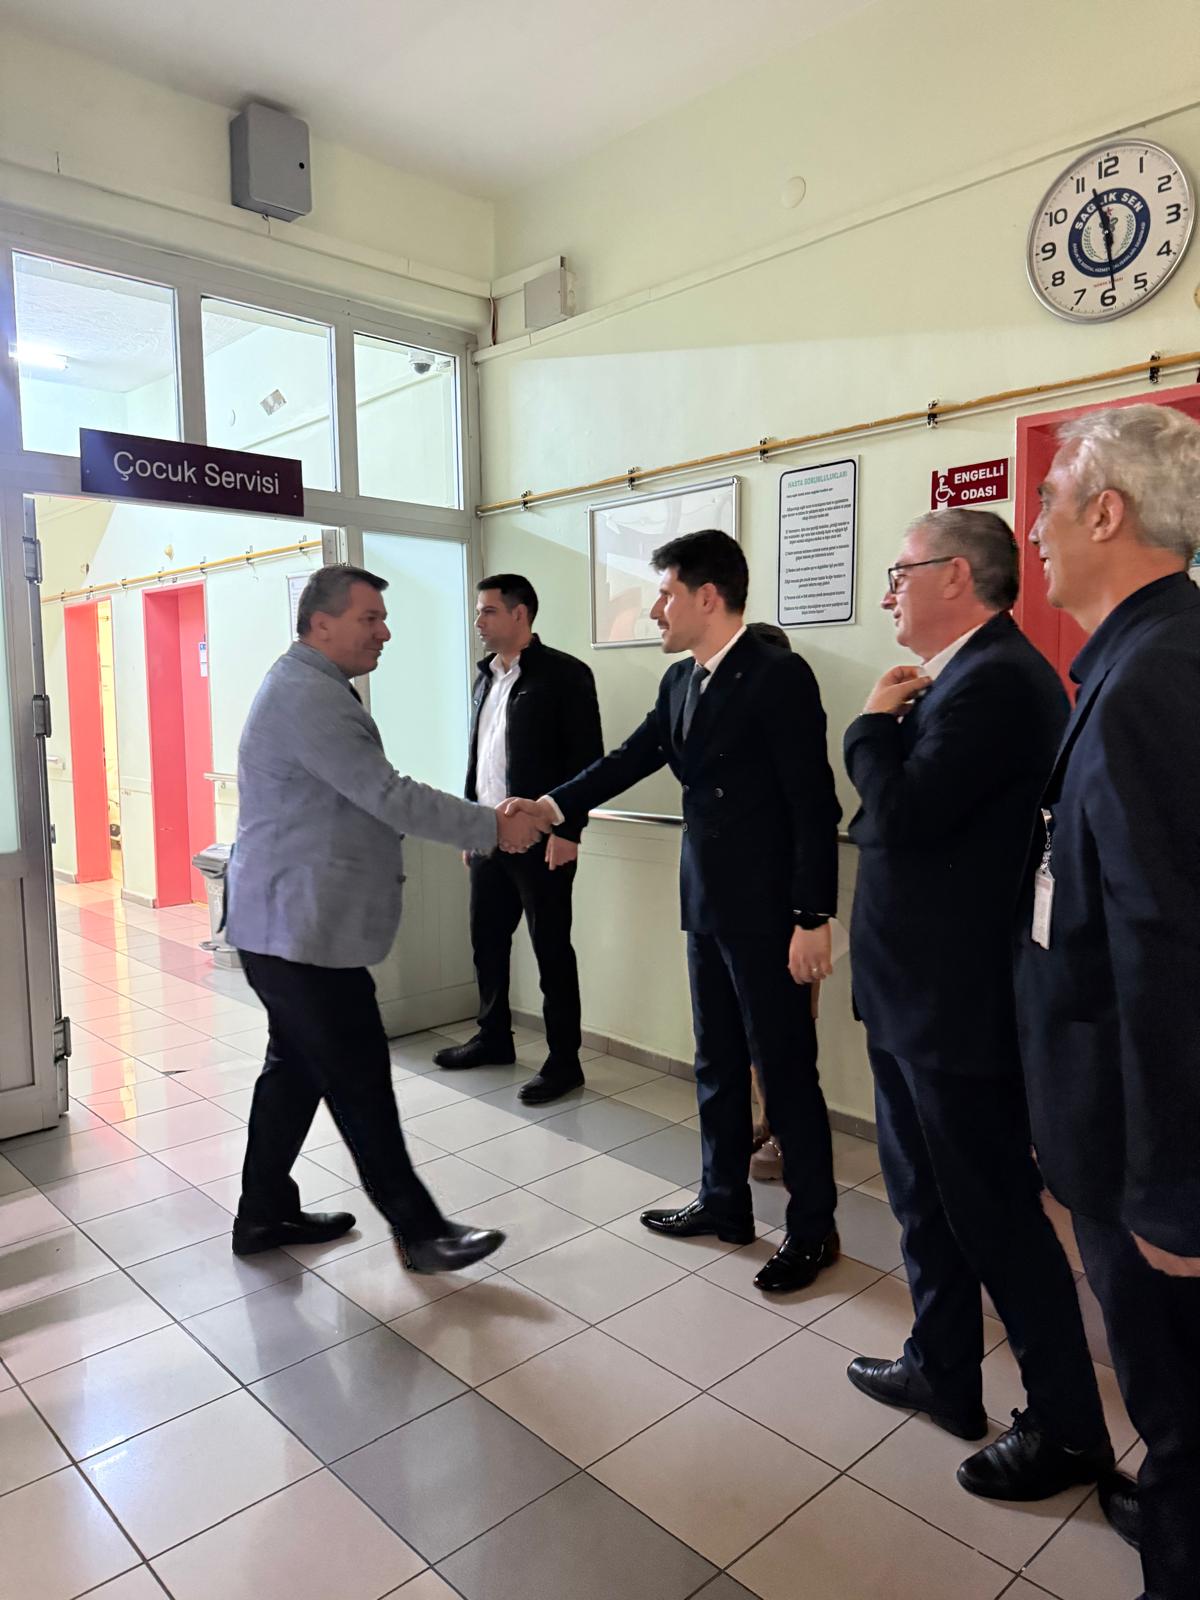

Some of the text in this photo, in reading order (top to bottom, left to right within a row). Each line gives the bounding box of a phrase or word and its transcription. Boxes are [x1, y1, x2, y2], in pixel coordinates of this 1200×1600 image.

[1098, 155, 1120, 179] 12
[1139, 156, 1144, 173] 1
[1076, 177, 1085, 193] 11
[1157, 175, 1172, 193] 2
[1121, 192, 1144, 213] SEN
[1048, 208, 1068, 227] 10
[1166, 203, 1181, 225] 3
[1041, 242, 1057, 261] 9
[1157, 240, 1173, 257] 4
[1051, 271, 1065, 287] 8
[1134, 272, 1148, 289] 5
[1074, 289, 1086, 306] 7
[1100, 288, 1116, 307] 6
[113, 451, 280, 495] Çocuk Servisi
[954, 463, 1004, 485] ENGELLİ
[961, 485, 997, 500] ODASI
